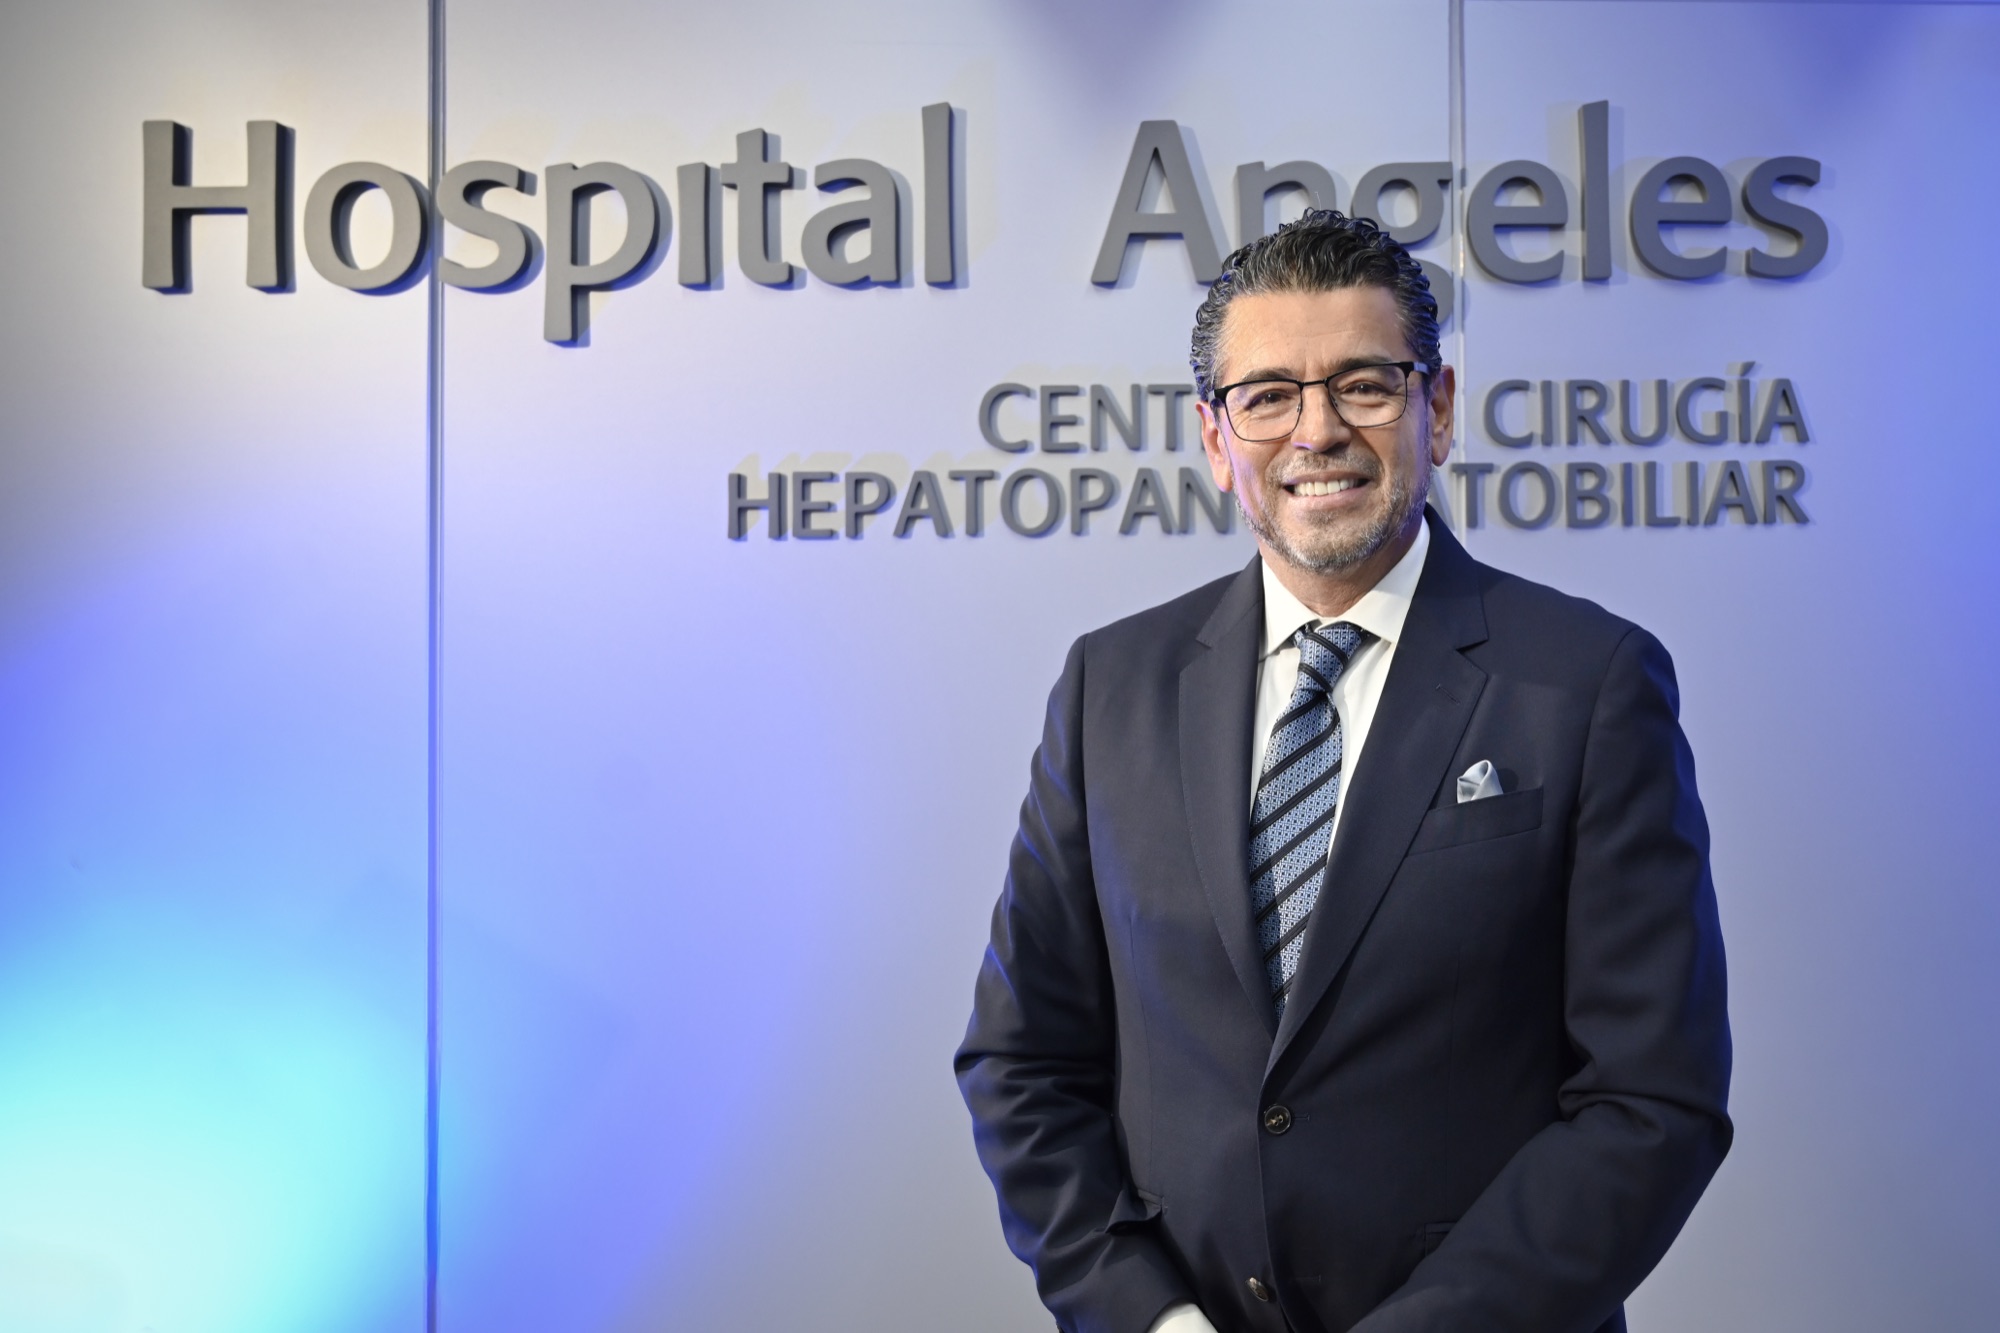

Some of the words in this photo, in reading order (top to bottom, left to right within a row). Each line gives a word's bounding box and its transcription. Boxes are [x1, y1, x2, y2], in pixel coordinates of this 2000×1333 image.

[142, 101, 955, 344] Hospital
[1091, 100, 1829, 327] Angeles
[978, 383, 1206, 453] CENT
[1483, 361, 1810, 448] CIRUGÍA
[727, 459, 1810, 540] HEPATOPANTOBILIAR
